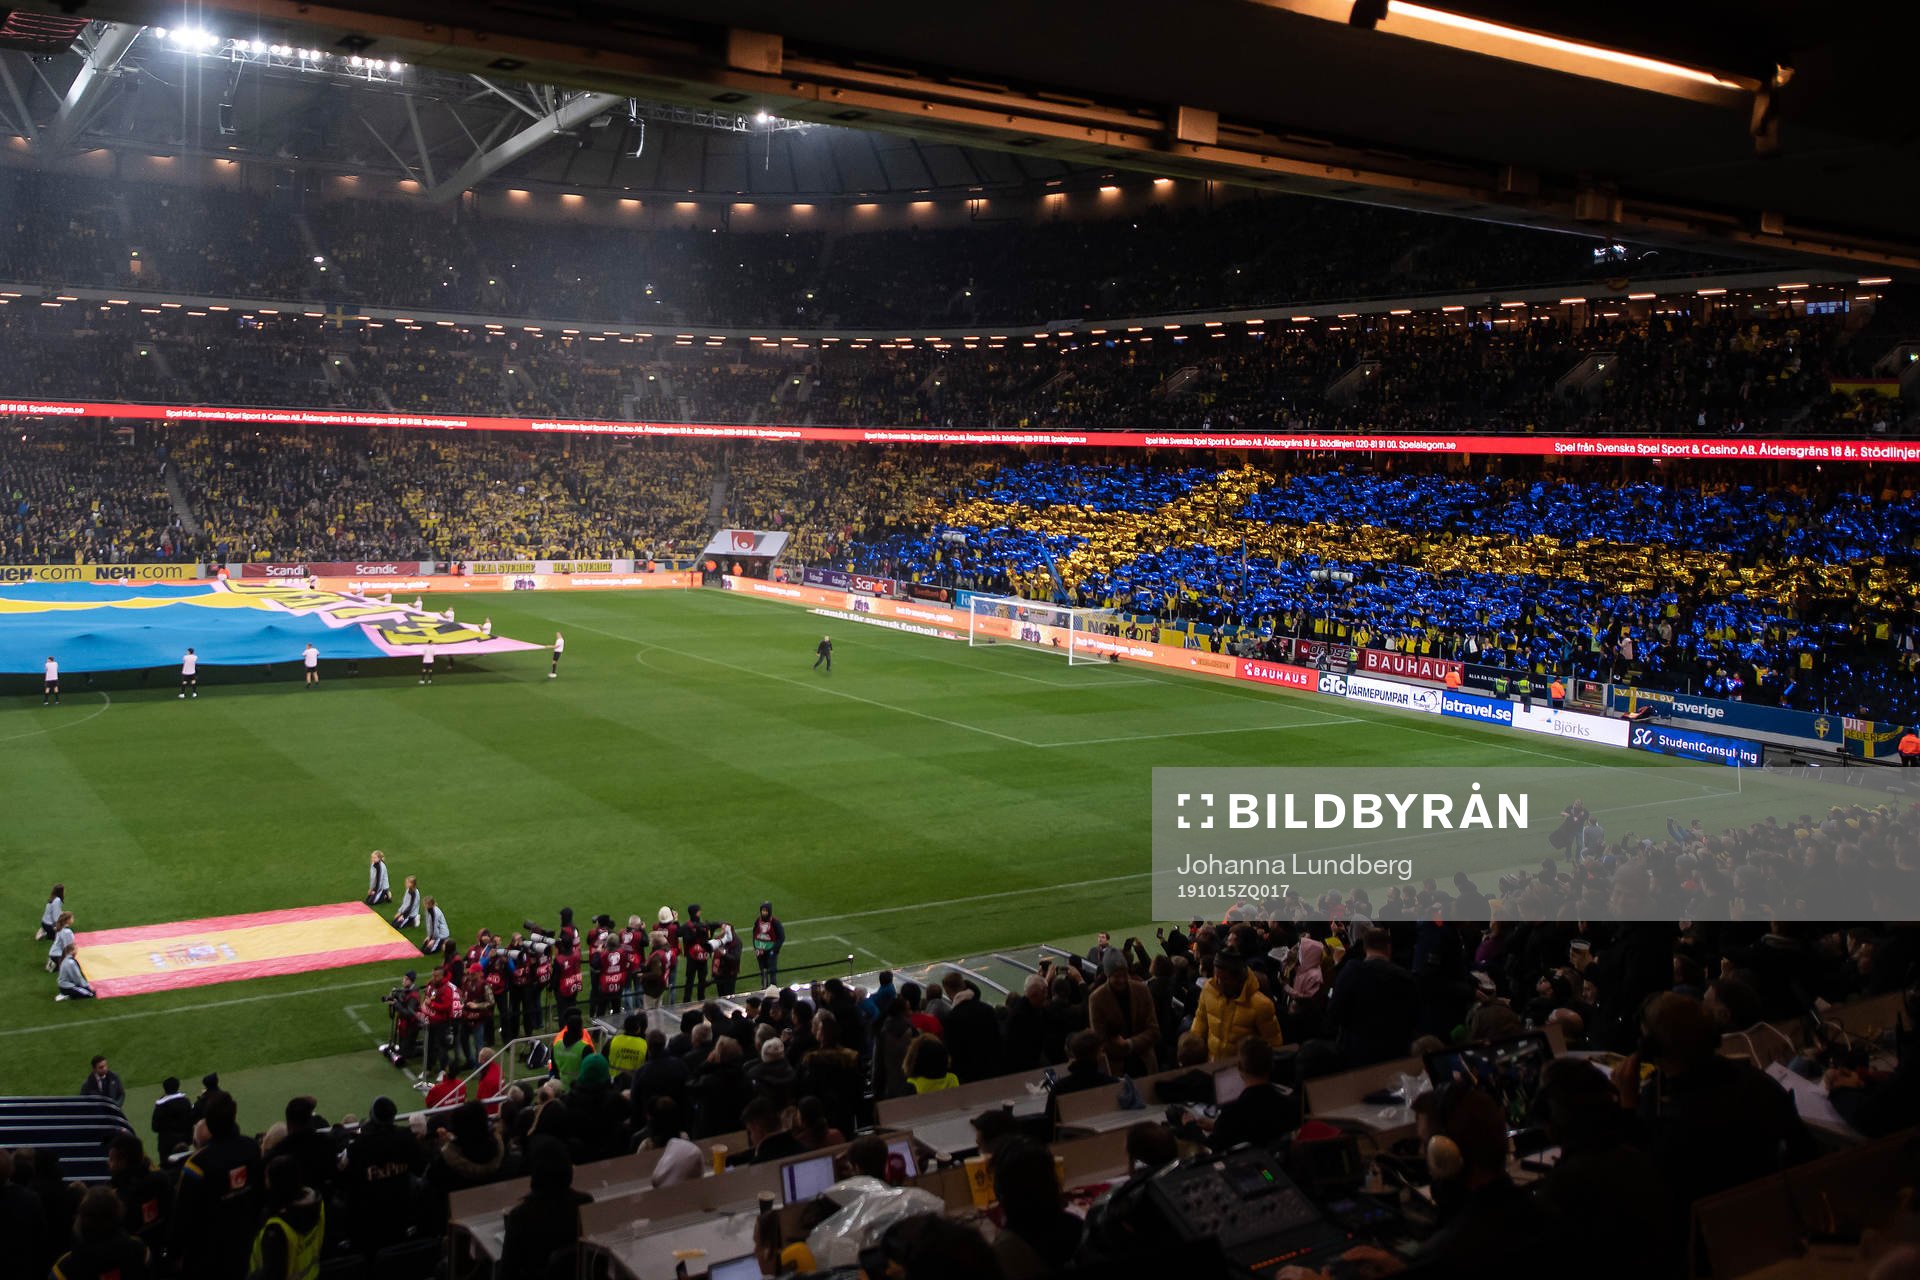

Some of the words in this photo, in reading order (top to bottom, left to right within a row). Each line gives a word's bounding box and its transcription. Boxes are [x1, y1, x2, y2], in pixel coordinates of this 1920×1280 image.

[1555, 443, 1575, 453] Spel
[1577, 443, 1595, 452] från
[1596, 444, 1635, 452] Svenska
[1638, 444, 1659, 454] Spel
[1662, 444, 1690, 455] Sport
[1692, 445, 1700, 453] &
[1702, 445, 1738, 454] Casino
[1740, 446, 1757, 454] AB.
[1759, 443, 1828, 457] Åldersgräns
[1831, 447, 1842, 456] 18
[1844, 446, 1858, 456] år.
[266, 565, 304, 576] Scandi
[355, 563, 398, 575] Scandic
[473, 562, 497, 574] HEJA
[498, 562, 536, 574] SVERIGE
[553, 562, 575, 573] HEJA
[576, 562, 612, 573] SVERIGE
[856, 577, 888, 594] Scanc
[899, 621, 938, 636] fotboll
[1367, 653, 1447, 679] BAUHAU
[1253, 667, 1307, 685] BAUHAUS
[1348, 682, 1409, 705] VÄRMEPUMPAR
[1413, 692, 1426, 703] LA
[1442, 696, 1512, 721] latravel.se
[1672, 701, 1725, 718] rsverige
[1553, 719, 1591, 737] Björks
[1844, 717, 1865, 733] DIF
[1632, 727, 1653, 745] SC
[1658, 734, 1758, 764] StudentConsuling
